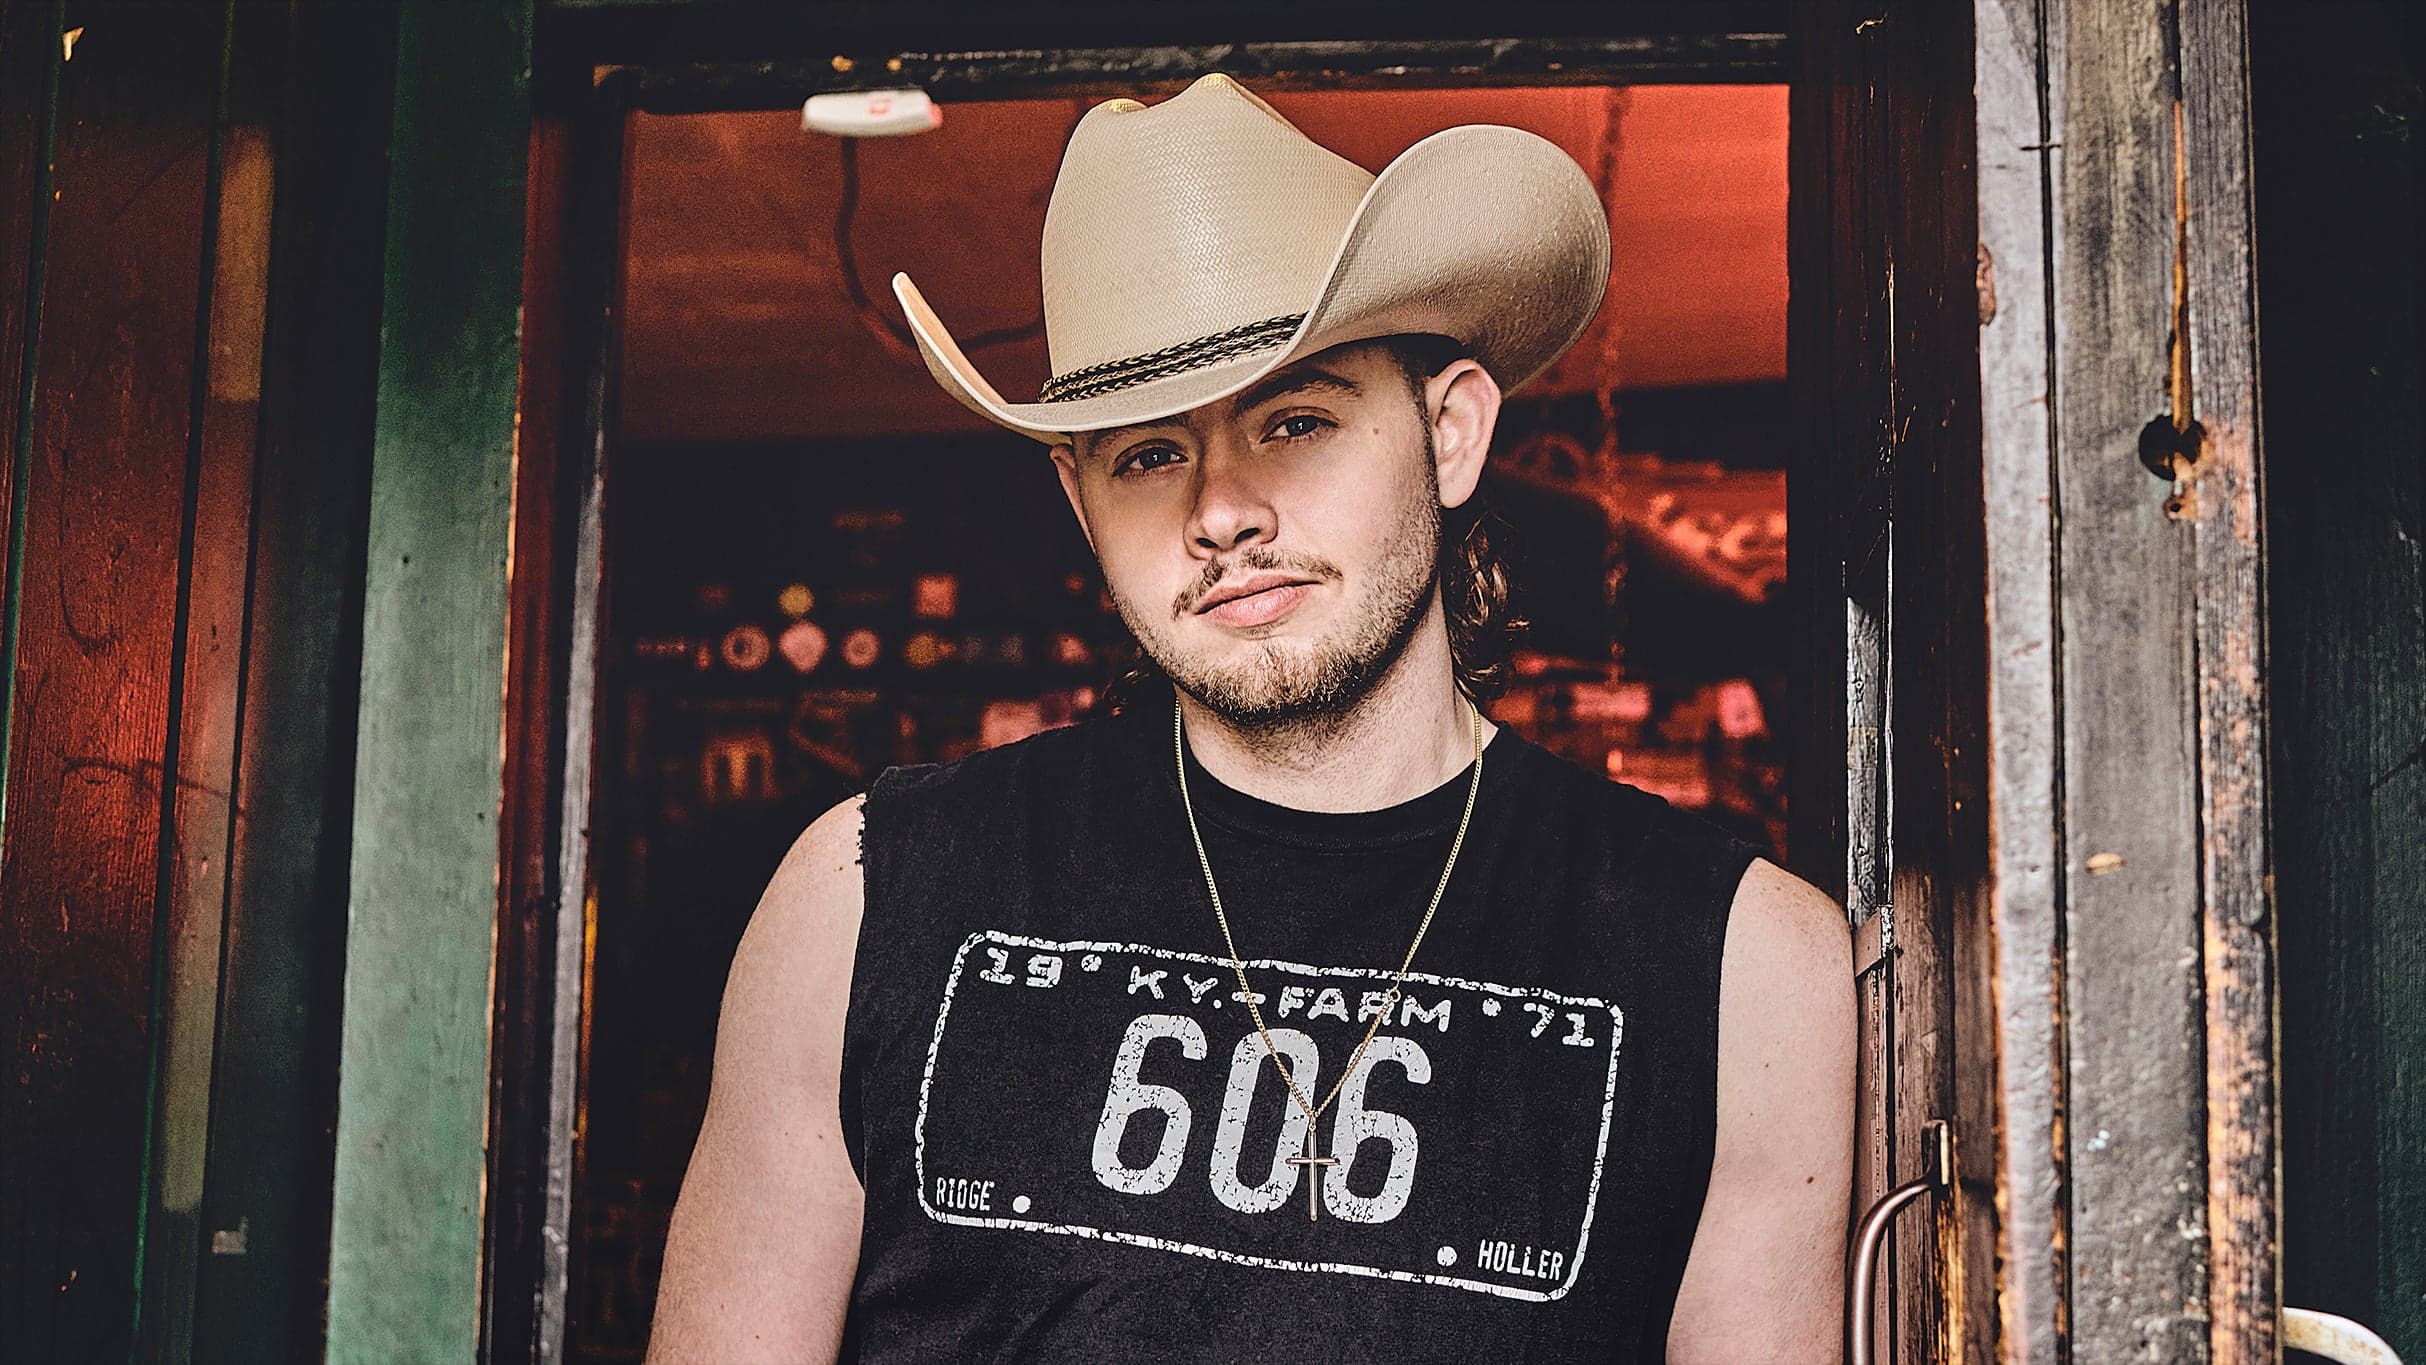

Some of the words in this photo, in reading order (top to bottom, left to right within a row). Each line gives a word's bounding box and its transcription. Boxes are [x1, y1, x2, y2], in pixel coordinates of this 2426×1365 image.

[979, 947, 1063, 989] 19
[1523, 1004, 1594, 1048] 71
[1091, 1014, 1432, 1224] 606
[936, 1177, 994, 1211] RIDGE
[1478, 1239, 1564, 1281] HOLLER
